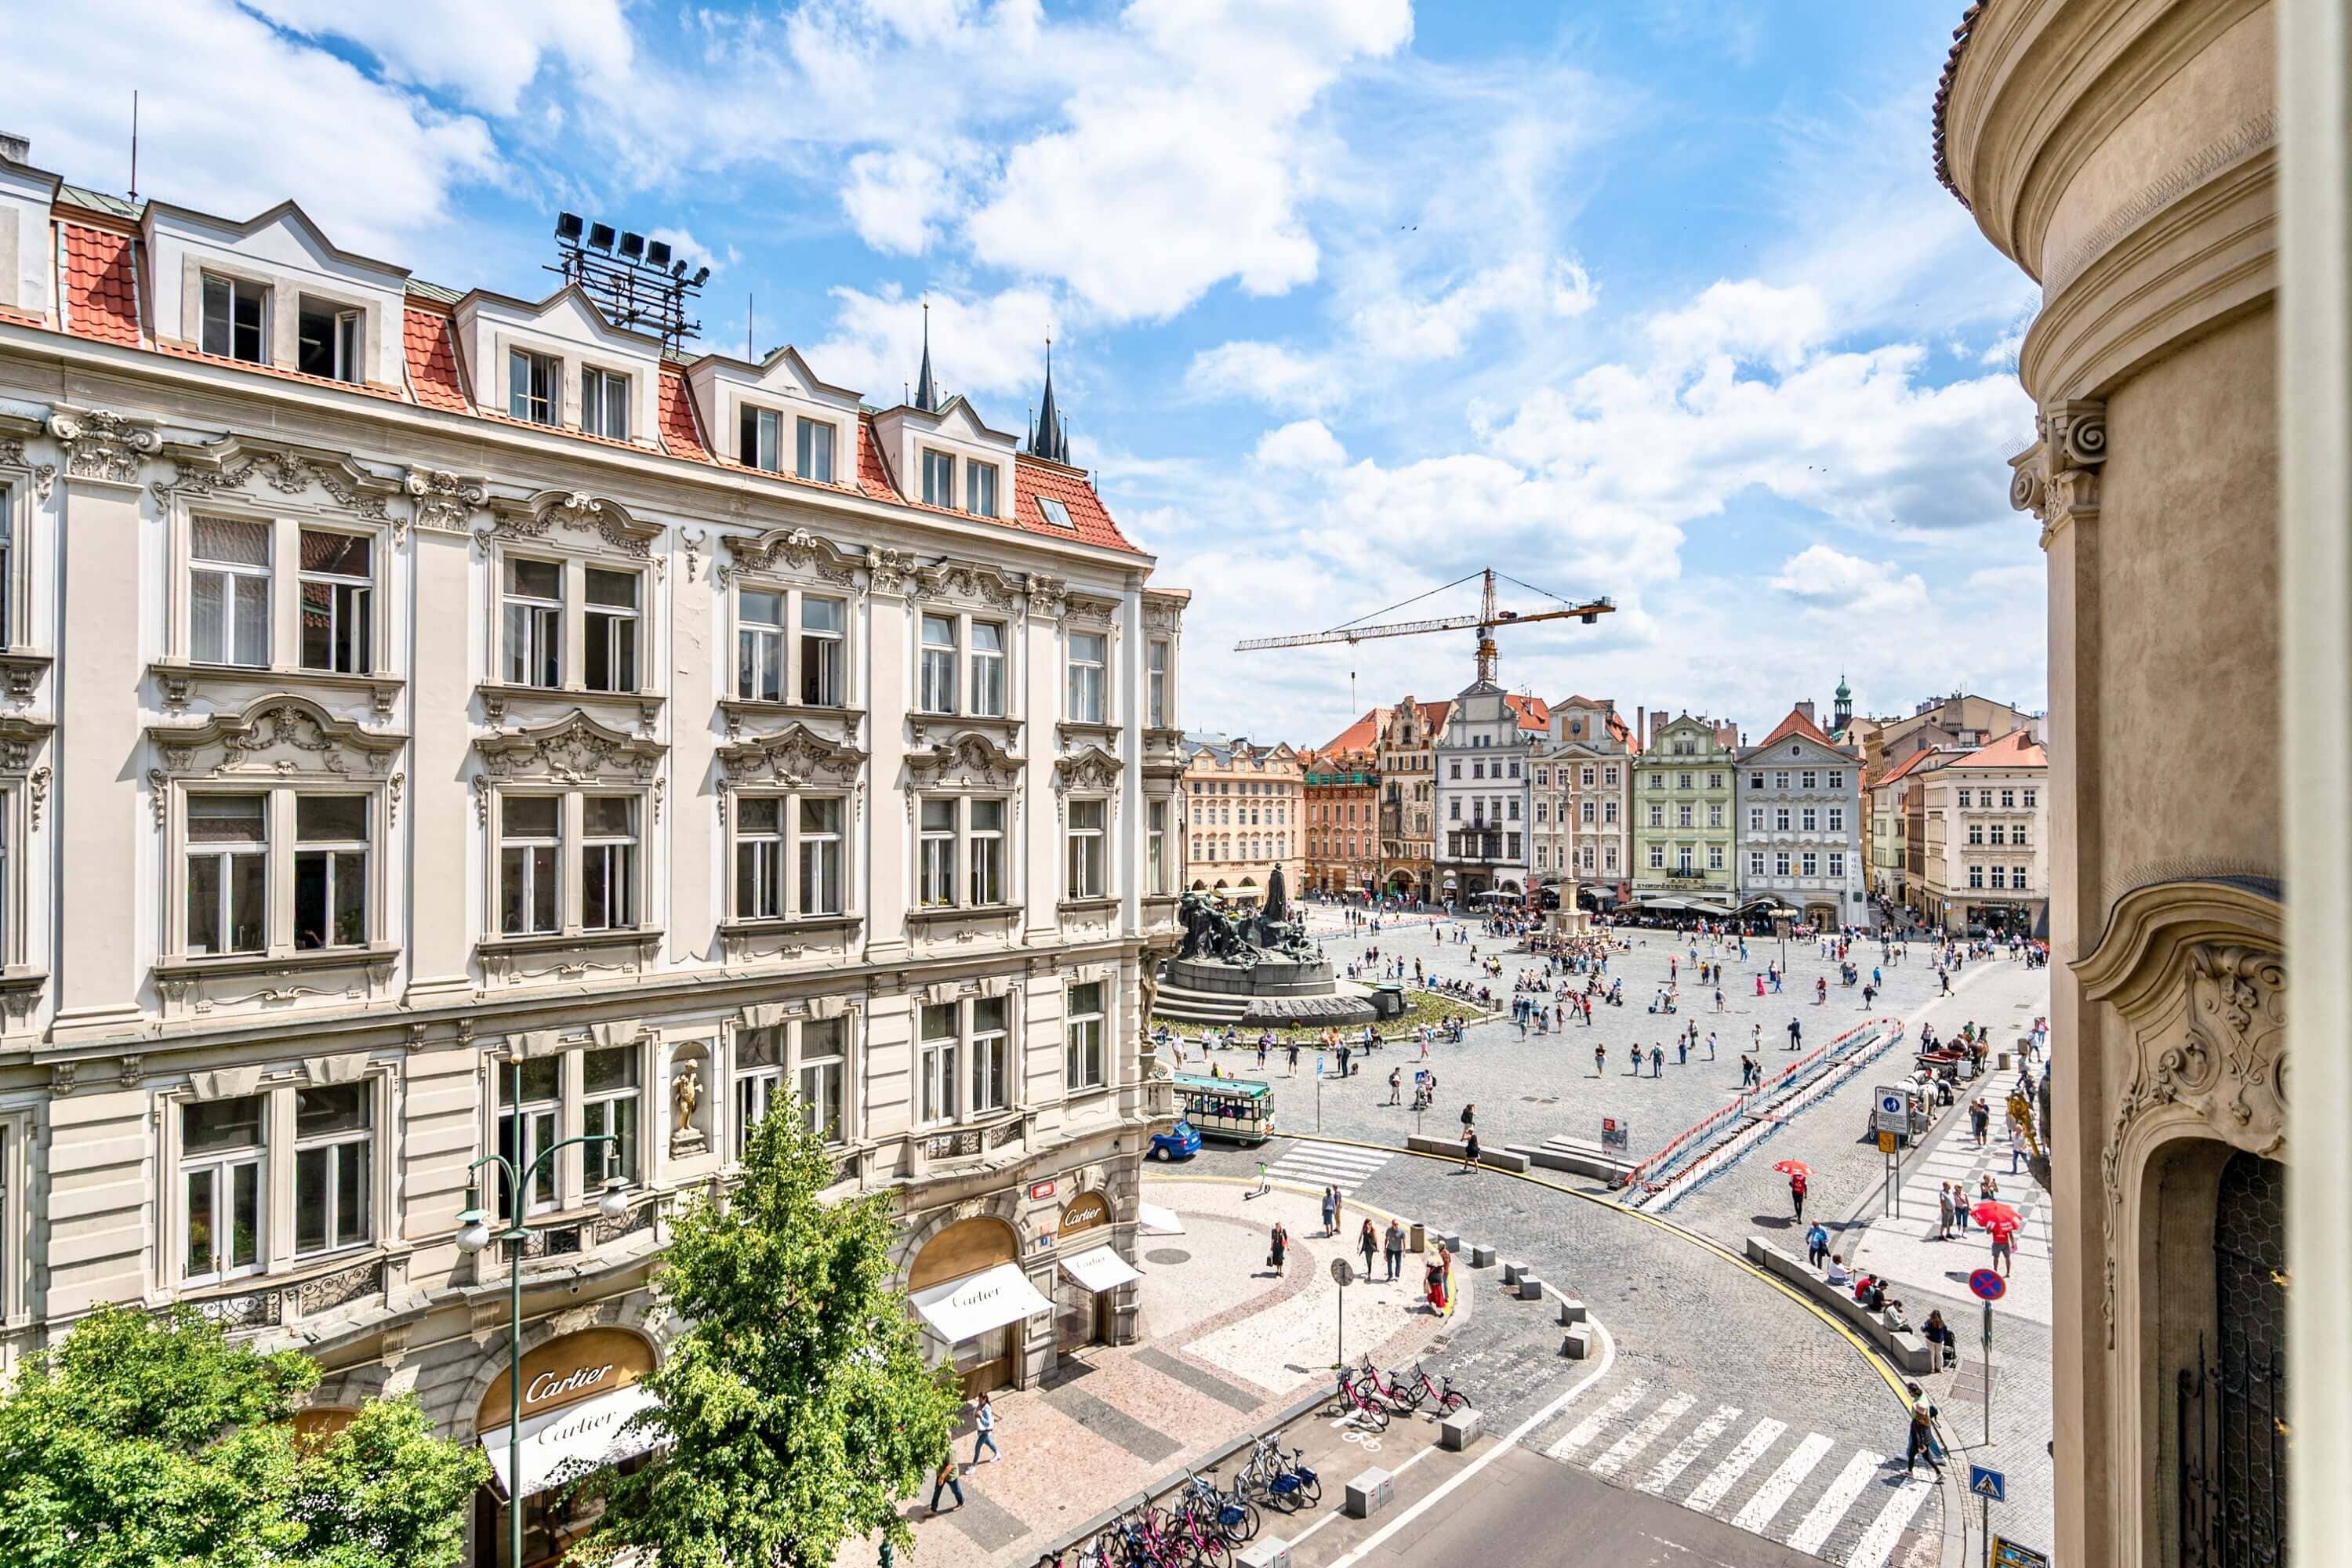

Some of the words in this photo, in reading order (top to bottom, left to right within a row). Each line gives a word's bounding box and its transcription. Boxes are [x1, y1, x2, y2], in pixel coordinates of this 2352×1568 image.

[1065, 1207, 1101, 1226] Cartier
[1076, 1254, 1106, 1269] Cartier
[953, 1287, 1001, 1308] Cartier
[526, 1363, 613, 1403] Cartier
[539, 1411, 617, 1445] Cartier
